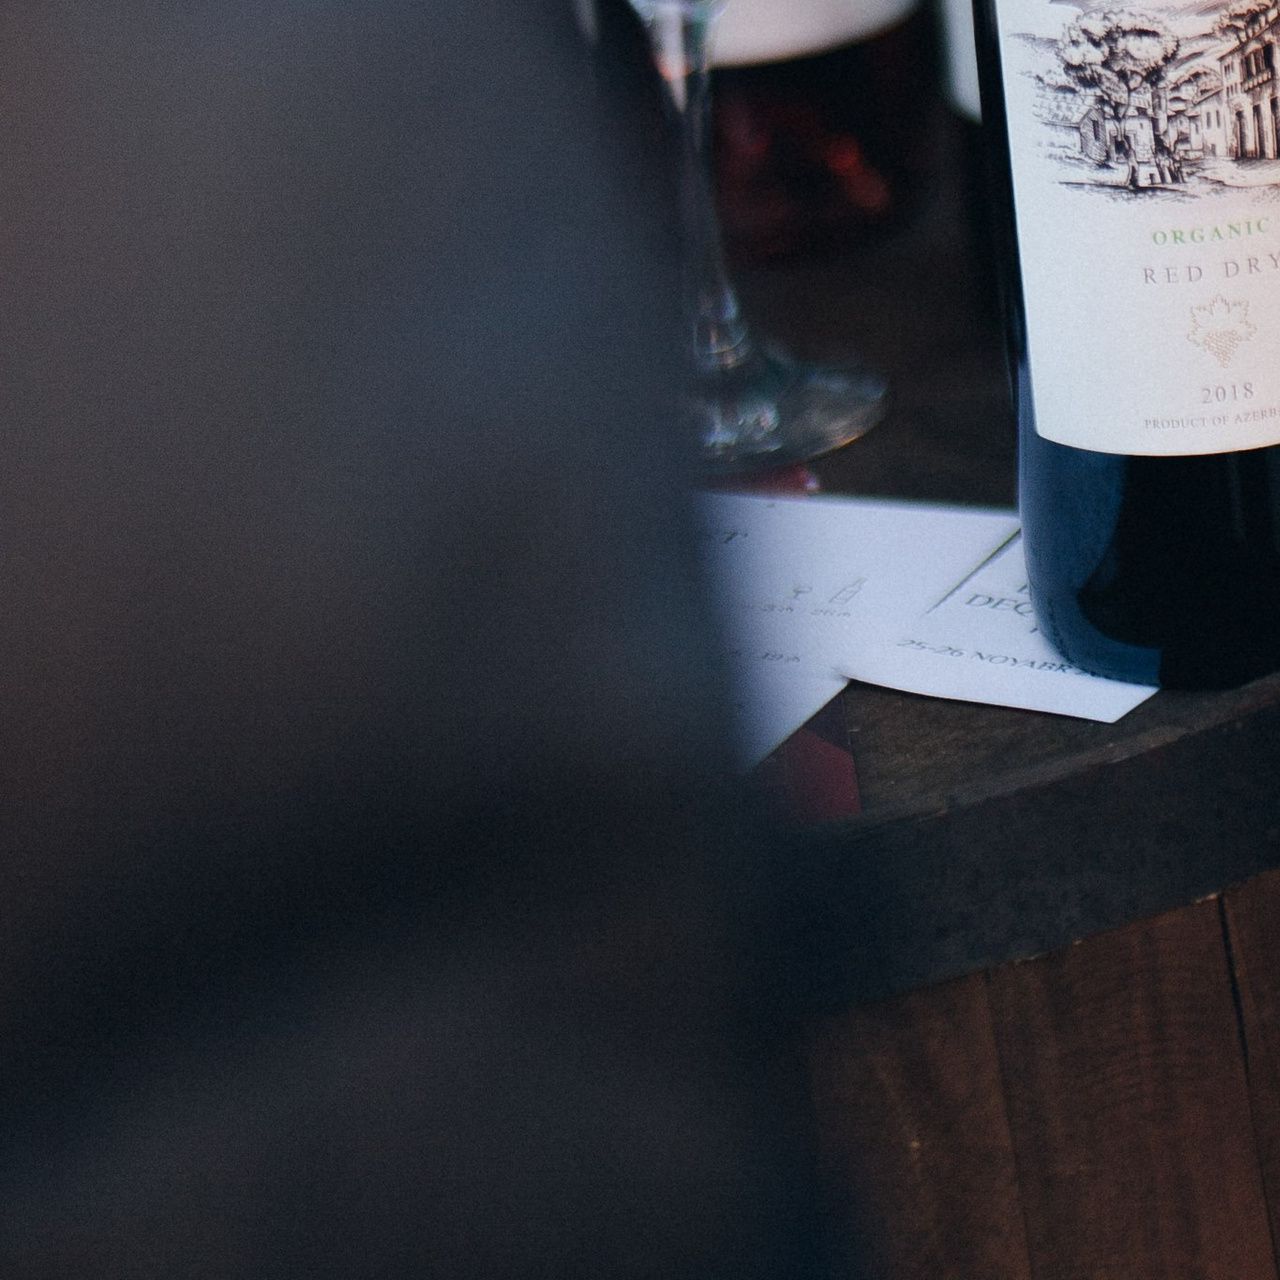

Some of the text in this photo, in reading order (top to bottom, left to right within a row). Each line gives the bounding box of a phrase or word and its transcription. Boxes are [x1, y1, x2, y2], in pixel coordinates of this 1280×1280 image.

[1153, 218, 1269, 245] ORGANIC
[1144, 266, 1203, 285] RED
[1202, 382, 1255, 404] 2018
[1144, 418, 1208, 431] PRODUCT
[1212, 415, 1230, 427] OF
